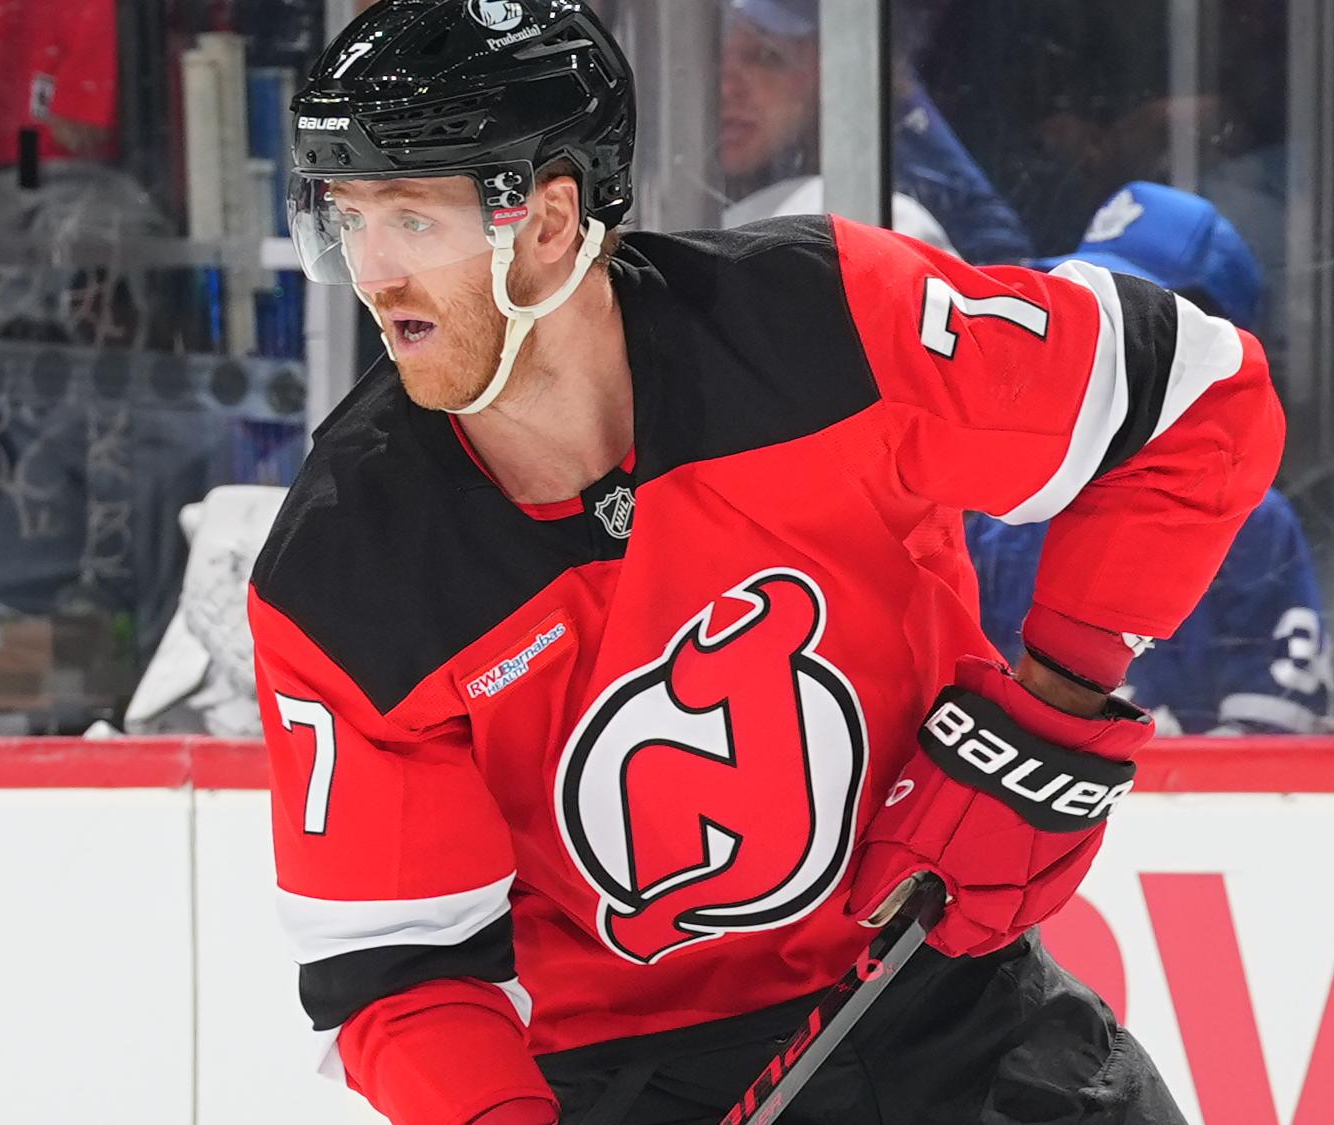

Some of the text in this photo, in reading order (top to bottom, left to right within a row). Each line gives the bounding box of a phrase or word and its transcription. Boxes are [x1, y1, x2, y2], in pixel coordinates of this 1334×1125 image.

[332, 42, 373, 79] 7
[486, 23, 542, 52] Prudential
[298, 116, 350, 130] BAUER
[920, 276, 1051, 361] 7
[469, 624, 565, 697] RWJBarnabas
[1270, 606, 1320, 694] 3
[274, 690, 336, 835] 7
